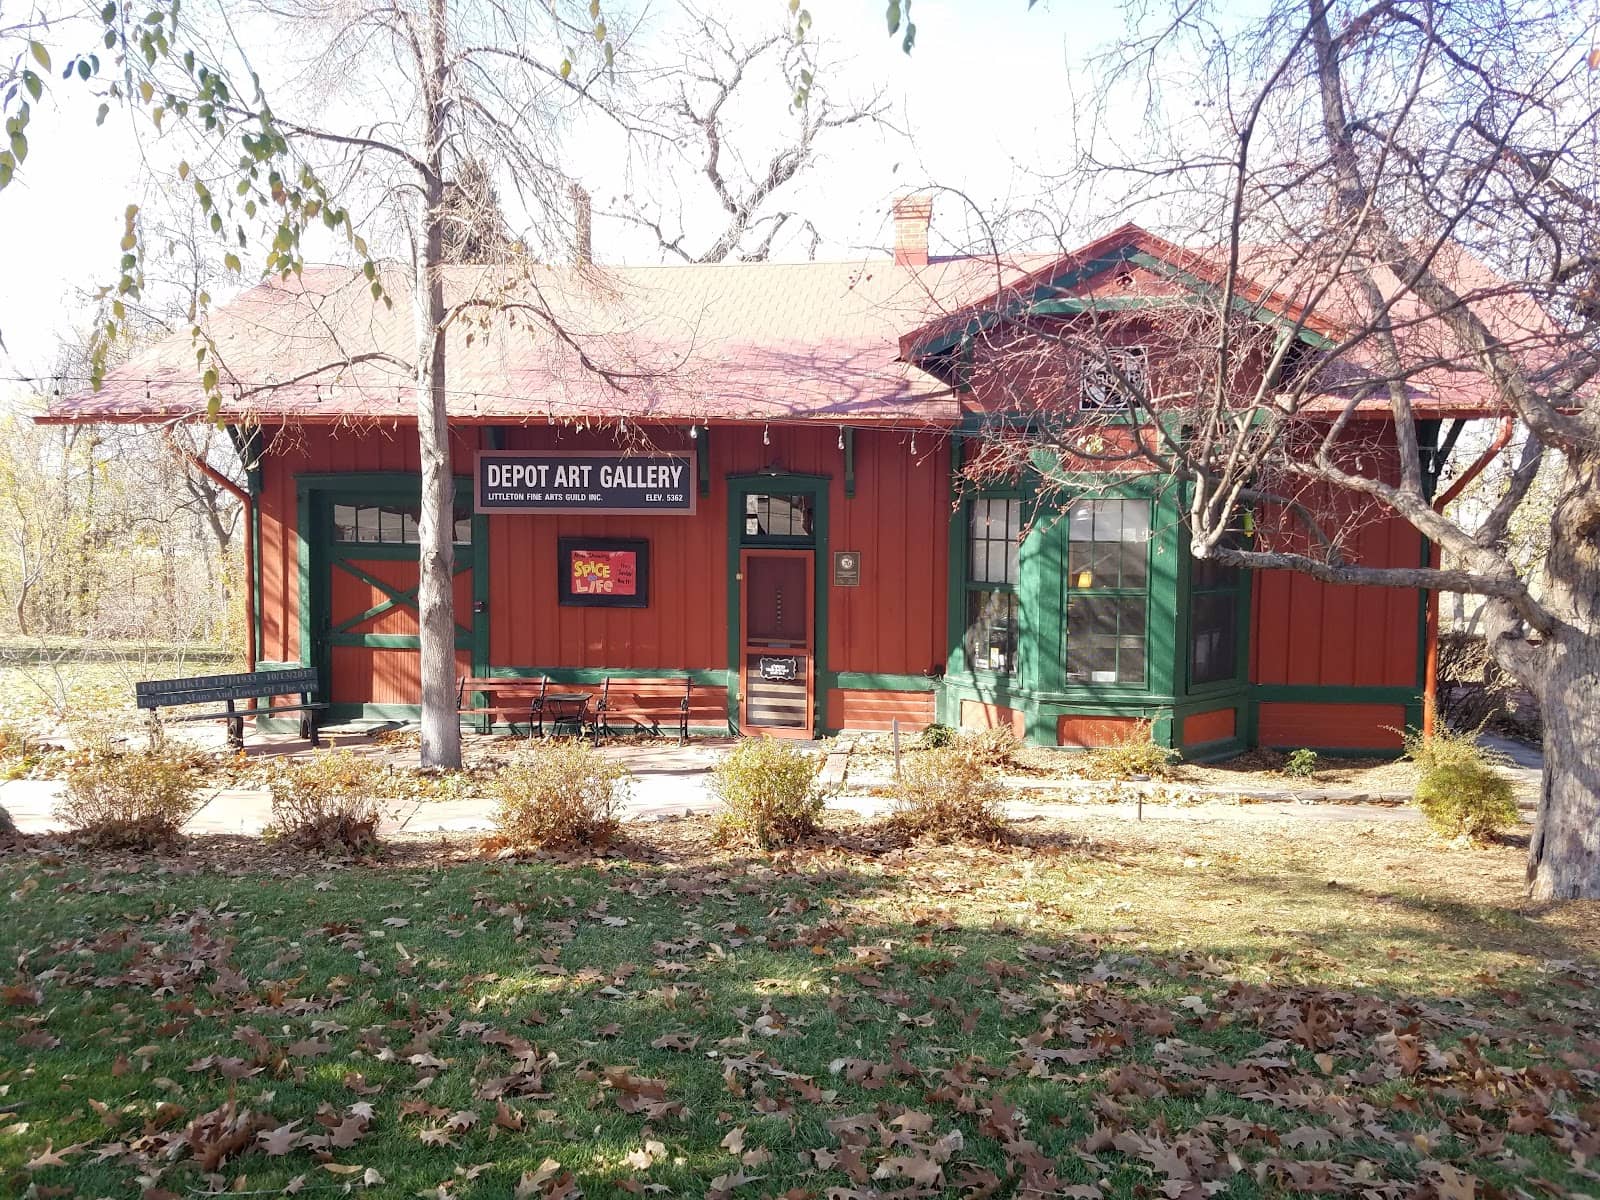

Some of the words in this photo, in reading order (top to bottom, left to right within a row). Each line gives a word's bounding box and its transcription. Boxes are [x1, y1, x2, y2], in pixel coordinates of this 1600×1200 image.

[487, 464, 549, 488] DEPOT
[554, 465, 592, 488] ART
[600, 465, 683, 489] GALLERY
[488, 493, 524, 501] LITTLETON
[526, 493, 543, 501] FINE
[544, 493, 563, 501] ARTS
[565, 493, 586, 501] GUILD
[645, 494, 664, 502] ELEV.
[666, 494, 684, 502] 5362
[215, 688, 233, 699] And
